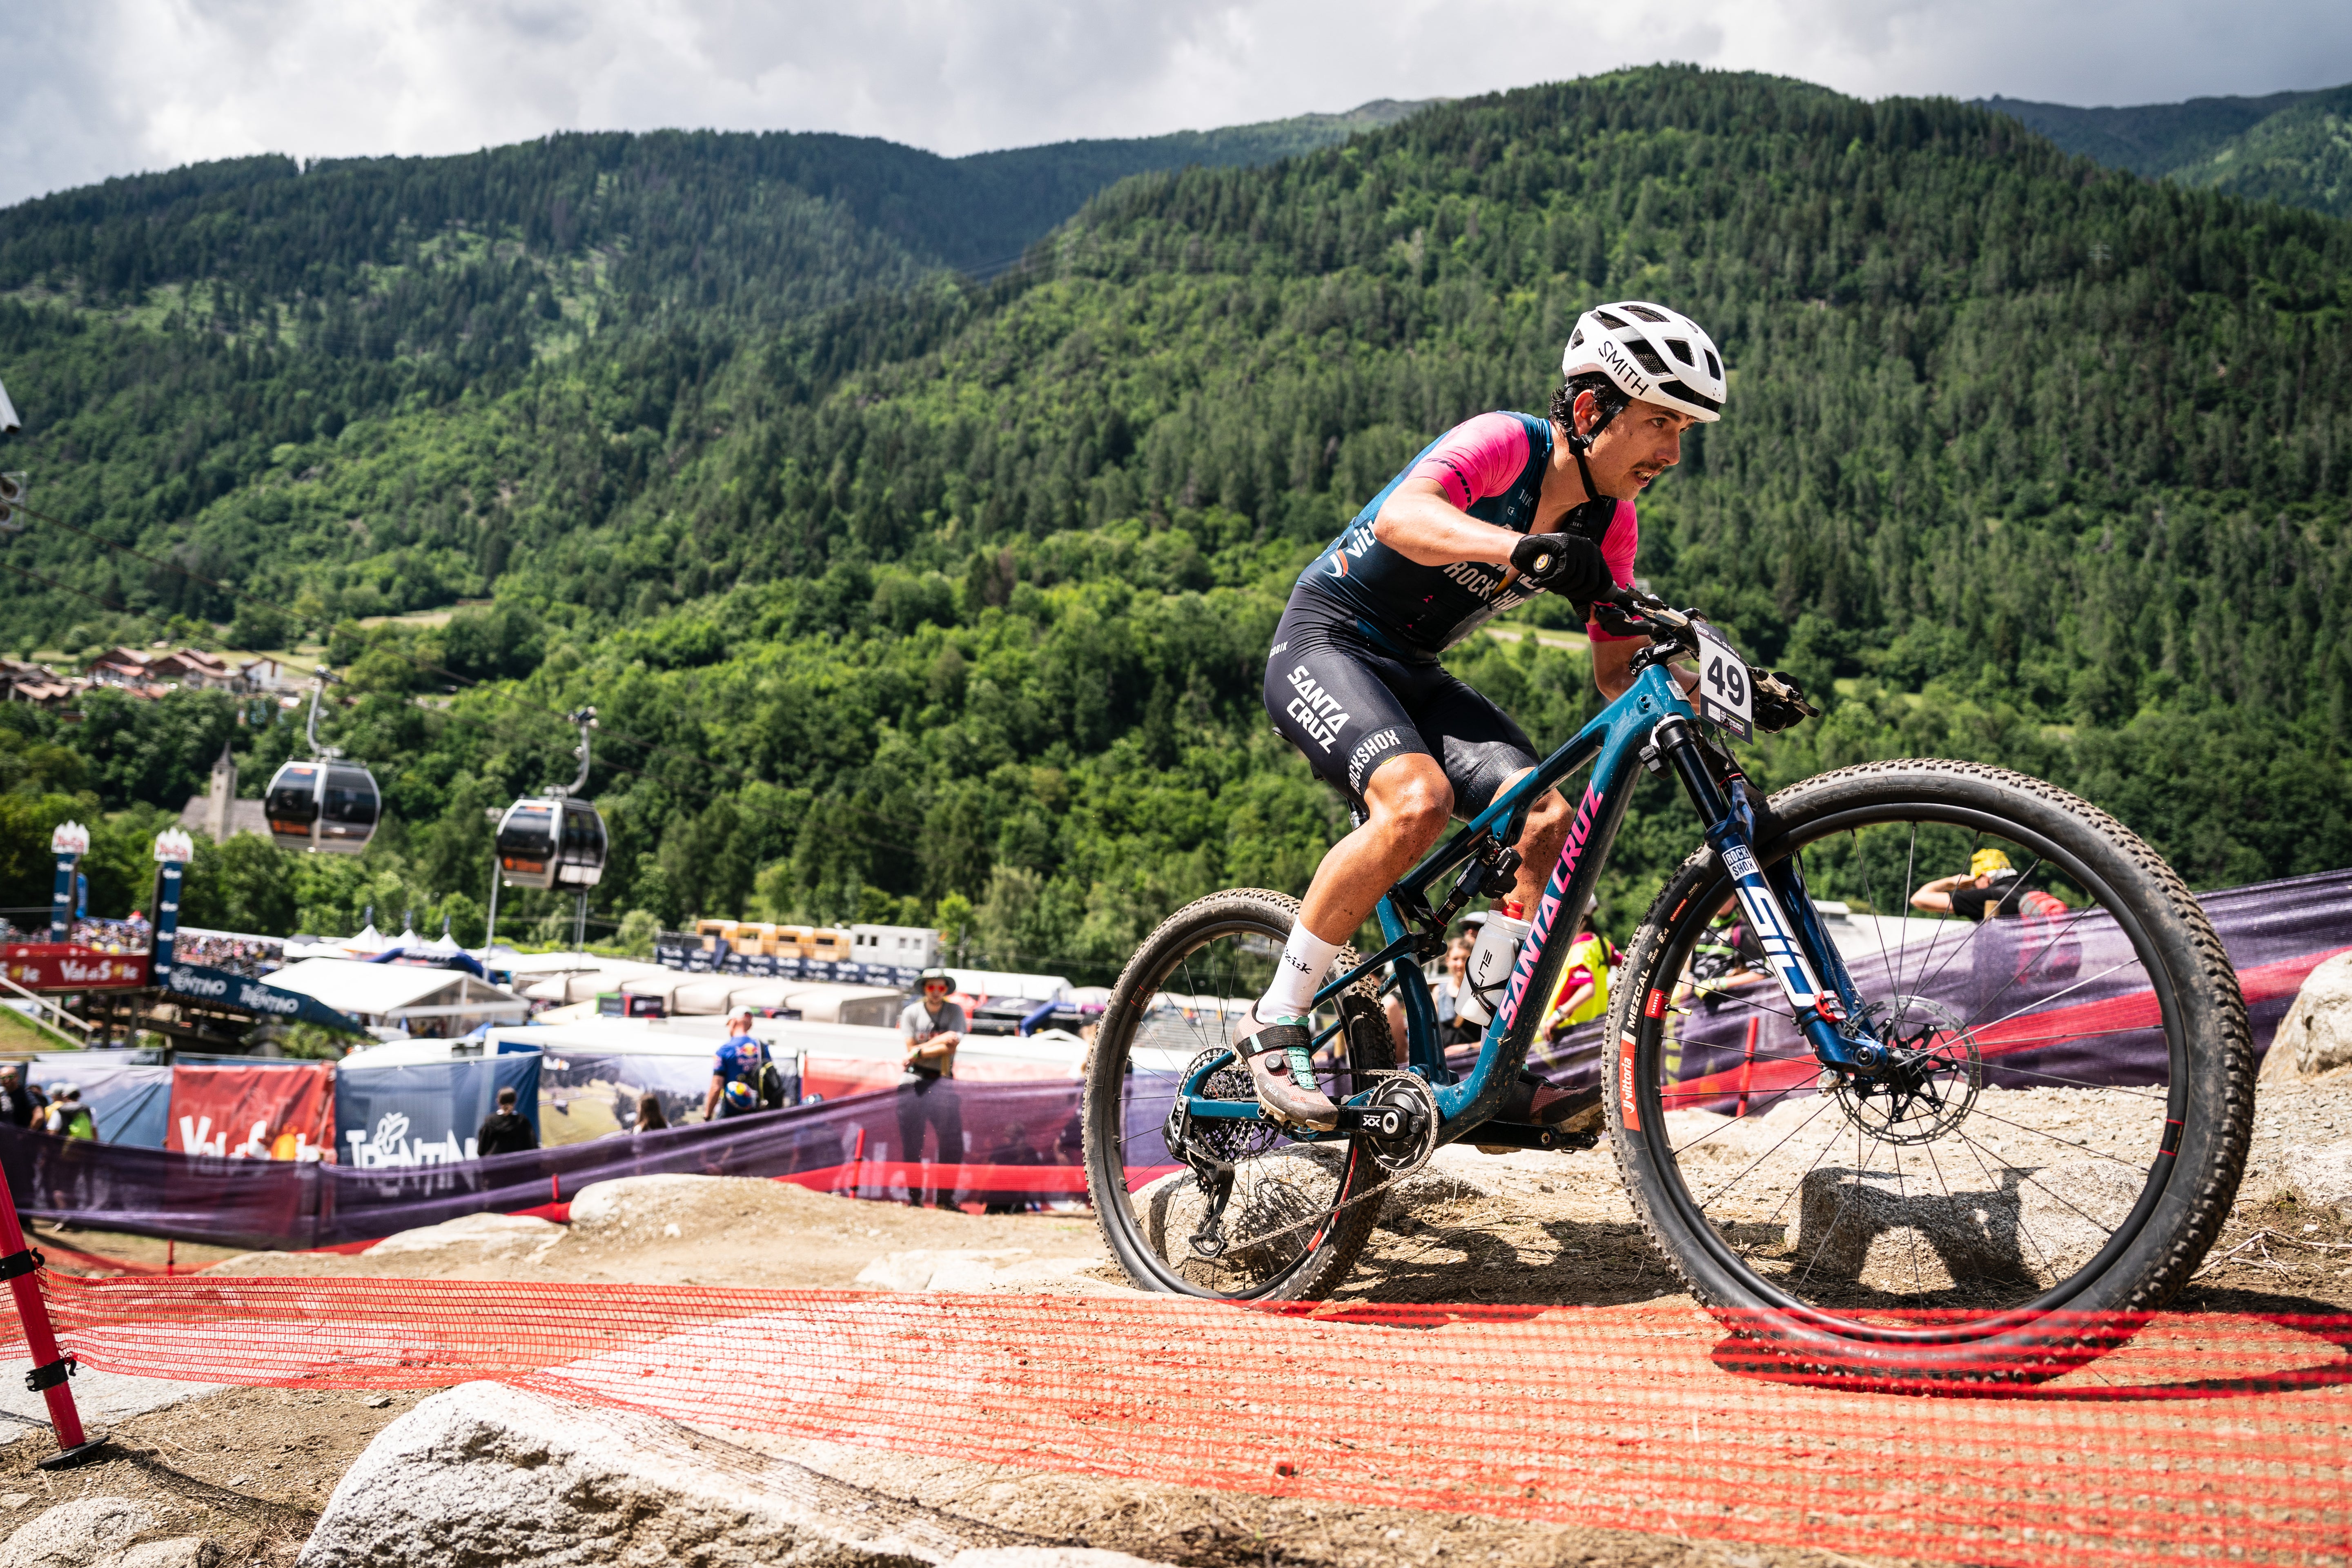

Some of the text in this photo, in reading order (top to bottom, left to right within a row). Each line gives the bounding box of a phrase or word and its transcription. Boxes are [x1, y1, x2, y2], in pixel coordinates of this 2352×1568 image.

[1598, 341, 1649, 396] SMITH
[1346, 520, 1377, 558] vitt
[1711, 634, 1722, 645] VAL
[1287, 665, 1351, 735] SANTA
[1707, 655, 1745, 707] 49
[1286, 697, 1337, 754] CRUZ
[1349, 729, 1401, 796] ROCKSHOX
[1725, 845, 1750, 866] ROCK
[1733, 860, 1756, 877] SHOX
[1499, 780, 1604, 1029] SANTA CRUZ
[1688, 882, 1699, 895] RACE
[1647, 951, 1653, 960] XC
[1659, 927, 1669, 944] 2.4
[1650, 948, 1659, 964] RACE
[1627, 969, 1650, 1029] MEZCAL
[1651, 993, 1660, 1014] RESERVE
[1621, 1056, 1633, 1099] vittoria
[1363, 1117, 1381, 1127] XX
[179, 1115, 227, 1178] Val
[346, 1129, 479, 1198] TRENTIN
